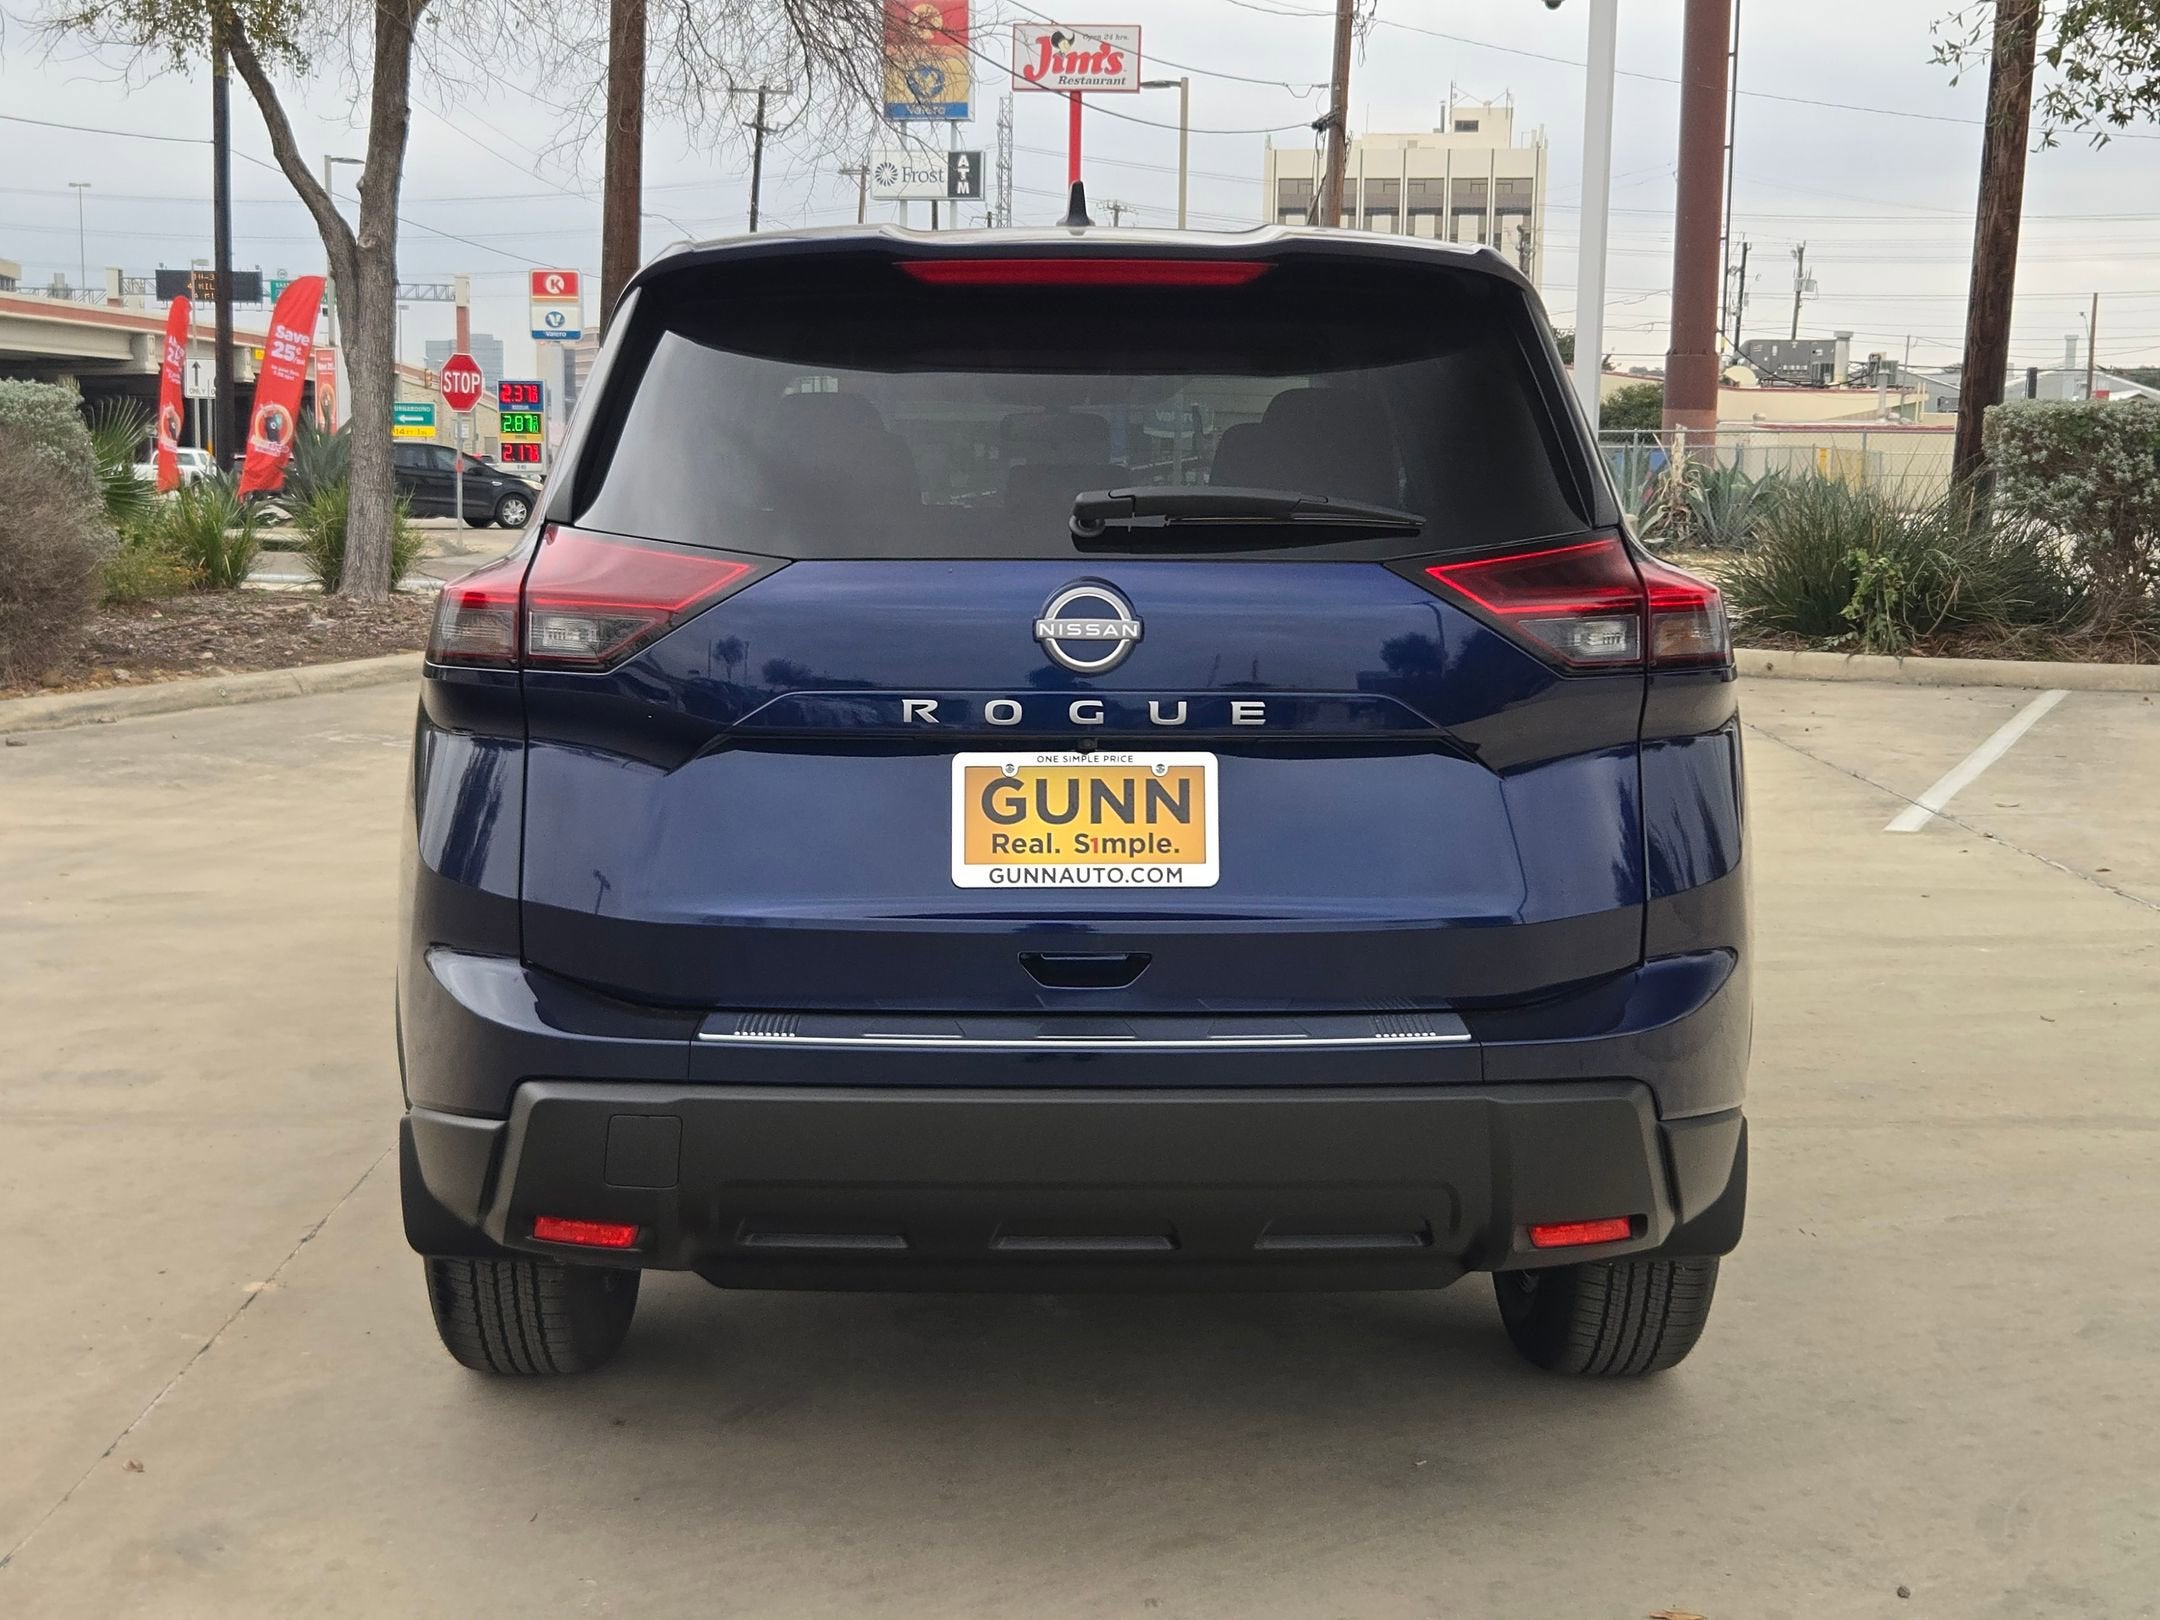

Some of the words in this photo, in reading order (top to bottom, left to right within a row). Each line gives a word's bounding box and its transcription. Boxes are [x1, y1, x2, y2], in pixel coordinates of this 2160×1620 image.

[1082, 33, 1101, 42] Open
[1104, 33, 1114, 41] 24
[1115, 33, 1129, 41] hrs.
[1023, 35, 1125, 82] Jim's
[1058, 75, 1127, 86] Restaurant
[902, 166, 945, 183] Frost
[957, 154, 970, 195] ATM
[274, 324, 310, 346] Save
[443, 371, 480, 394] STOP
[503, 415, 533, 433] 2.87
[1038, 622, 1139, 638] NISSAN
[902, 699, 1267, 726] ROGUE
[1036, 755, 1060, 763] ONE
[1063, 755, 1100, 763] SIMPLE
[1103, 755, 1134, 763] PRICE
[981, 777, 1191, 825] GUNN
[991, 832, 1061, 854] Real.
[988, 867, 1183, 884] GUNNAUTO.COM
